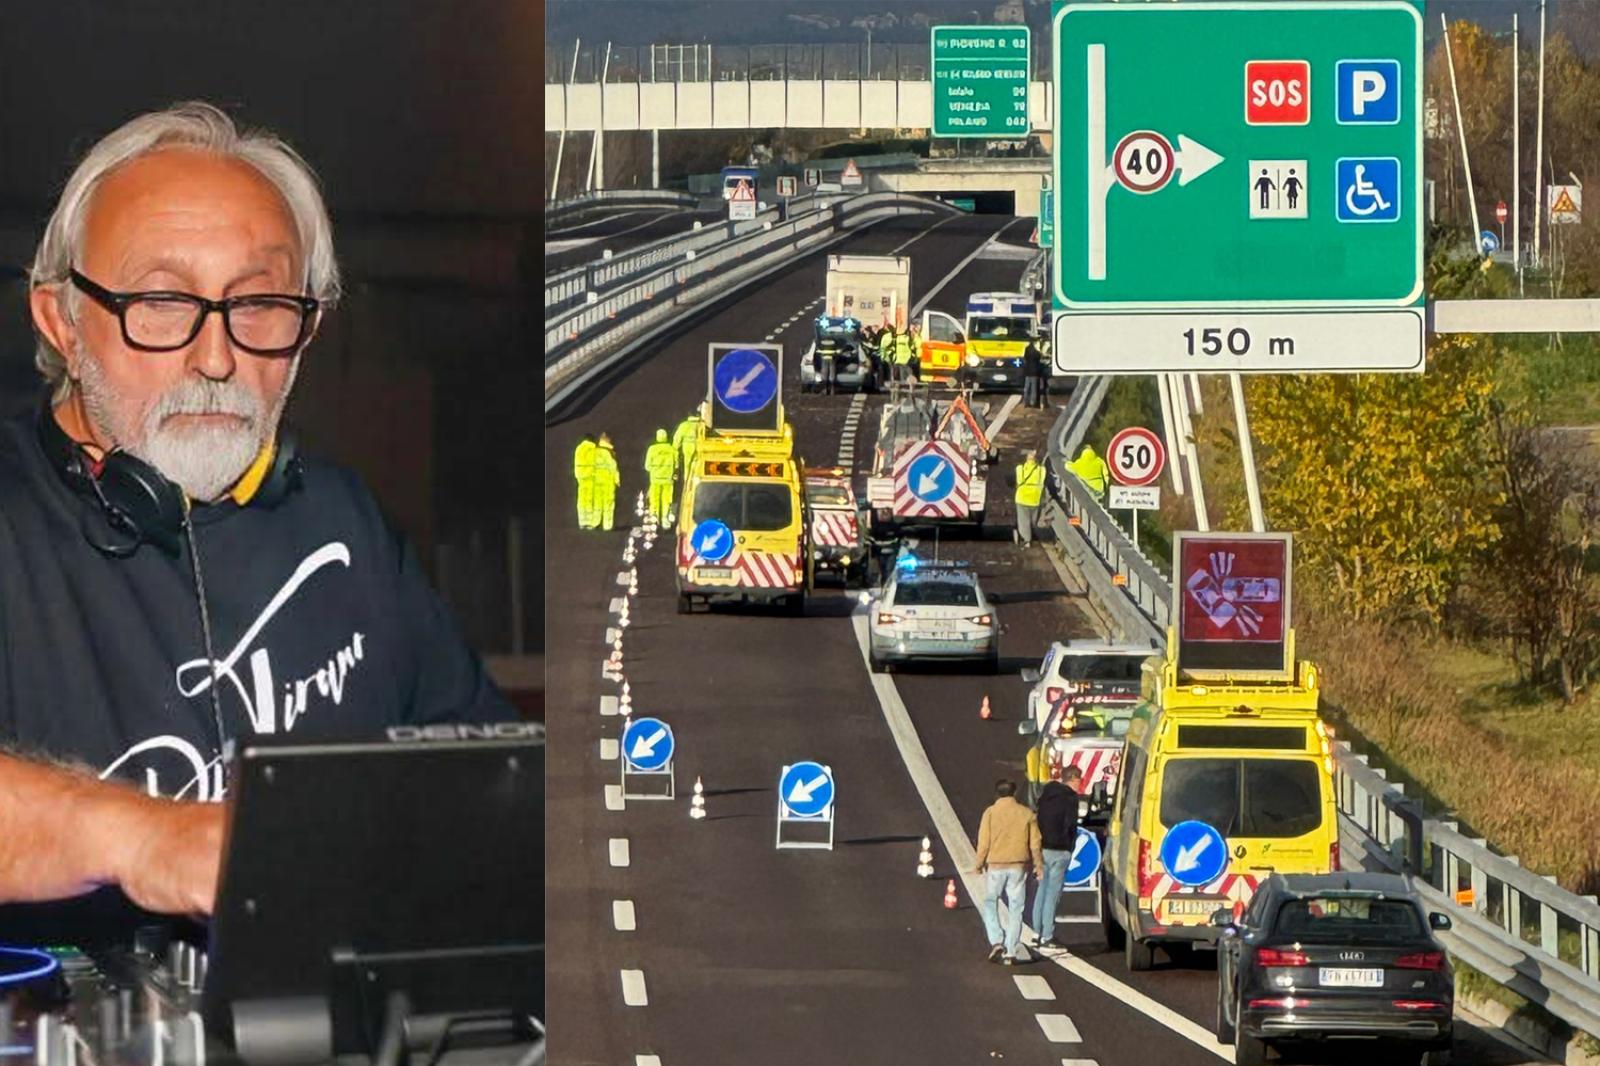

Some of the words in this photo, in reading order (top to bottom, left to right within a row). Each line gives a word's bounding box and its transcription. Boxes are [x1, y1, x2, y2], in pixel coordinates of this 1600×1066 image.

[1251, 78, 1303, 108] SOS
[1352, 70, 1387, 116] P
[1126, 148, 1162, 175] 40
[1182, 327, 1251, 357] 150
[1268, 336, 1295, 356] m
[1120, 444, 1151, 470] 50
